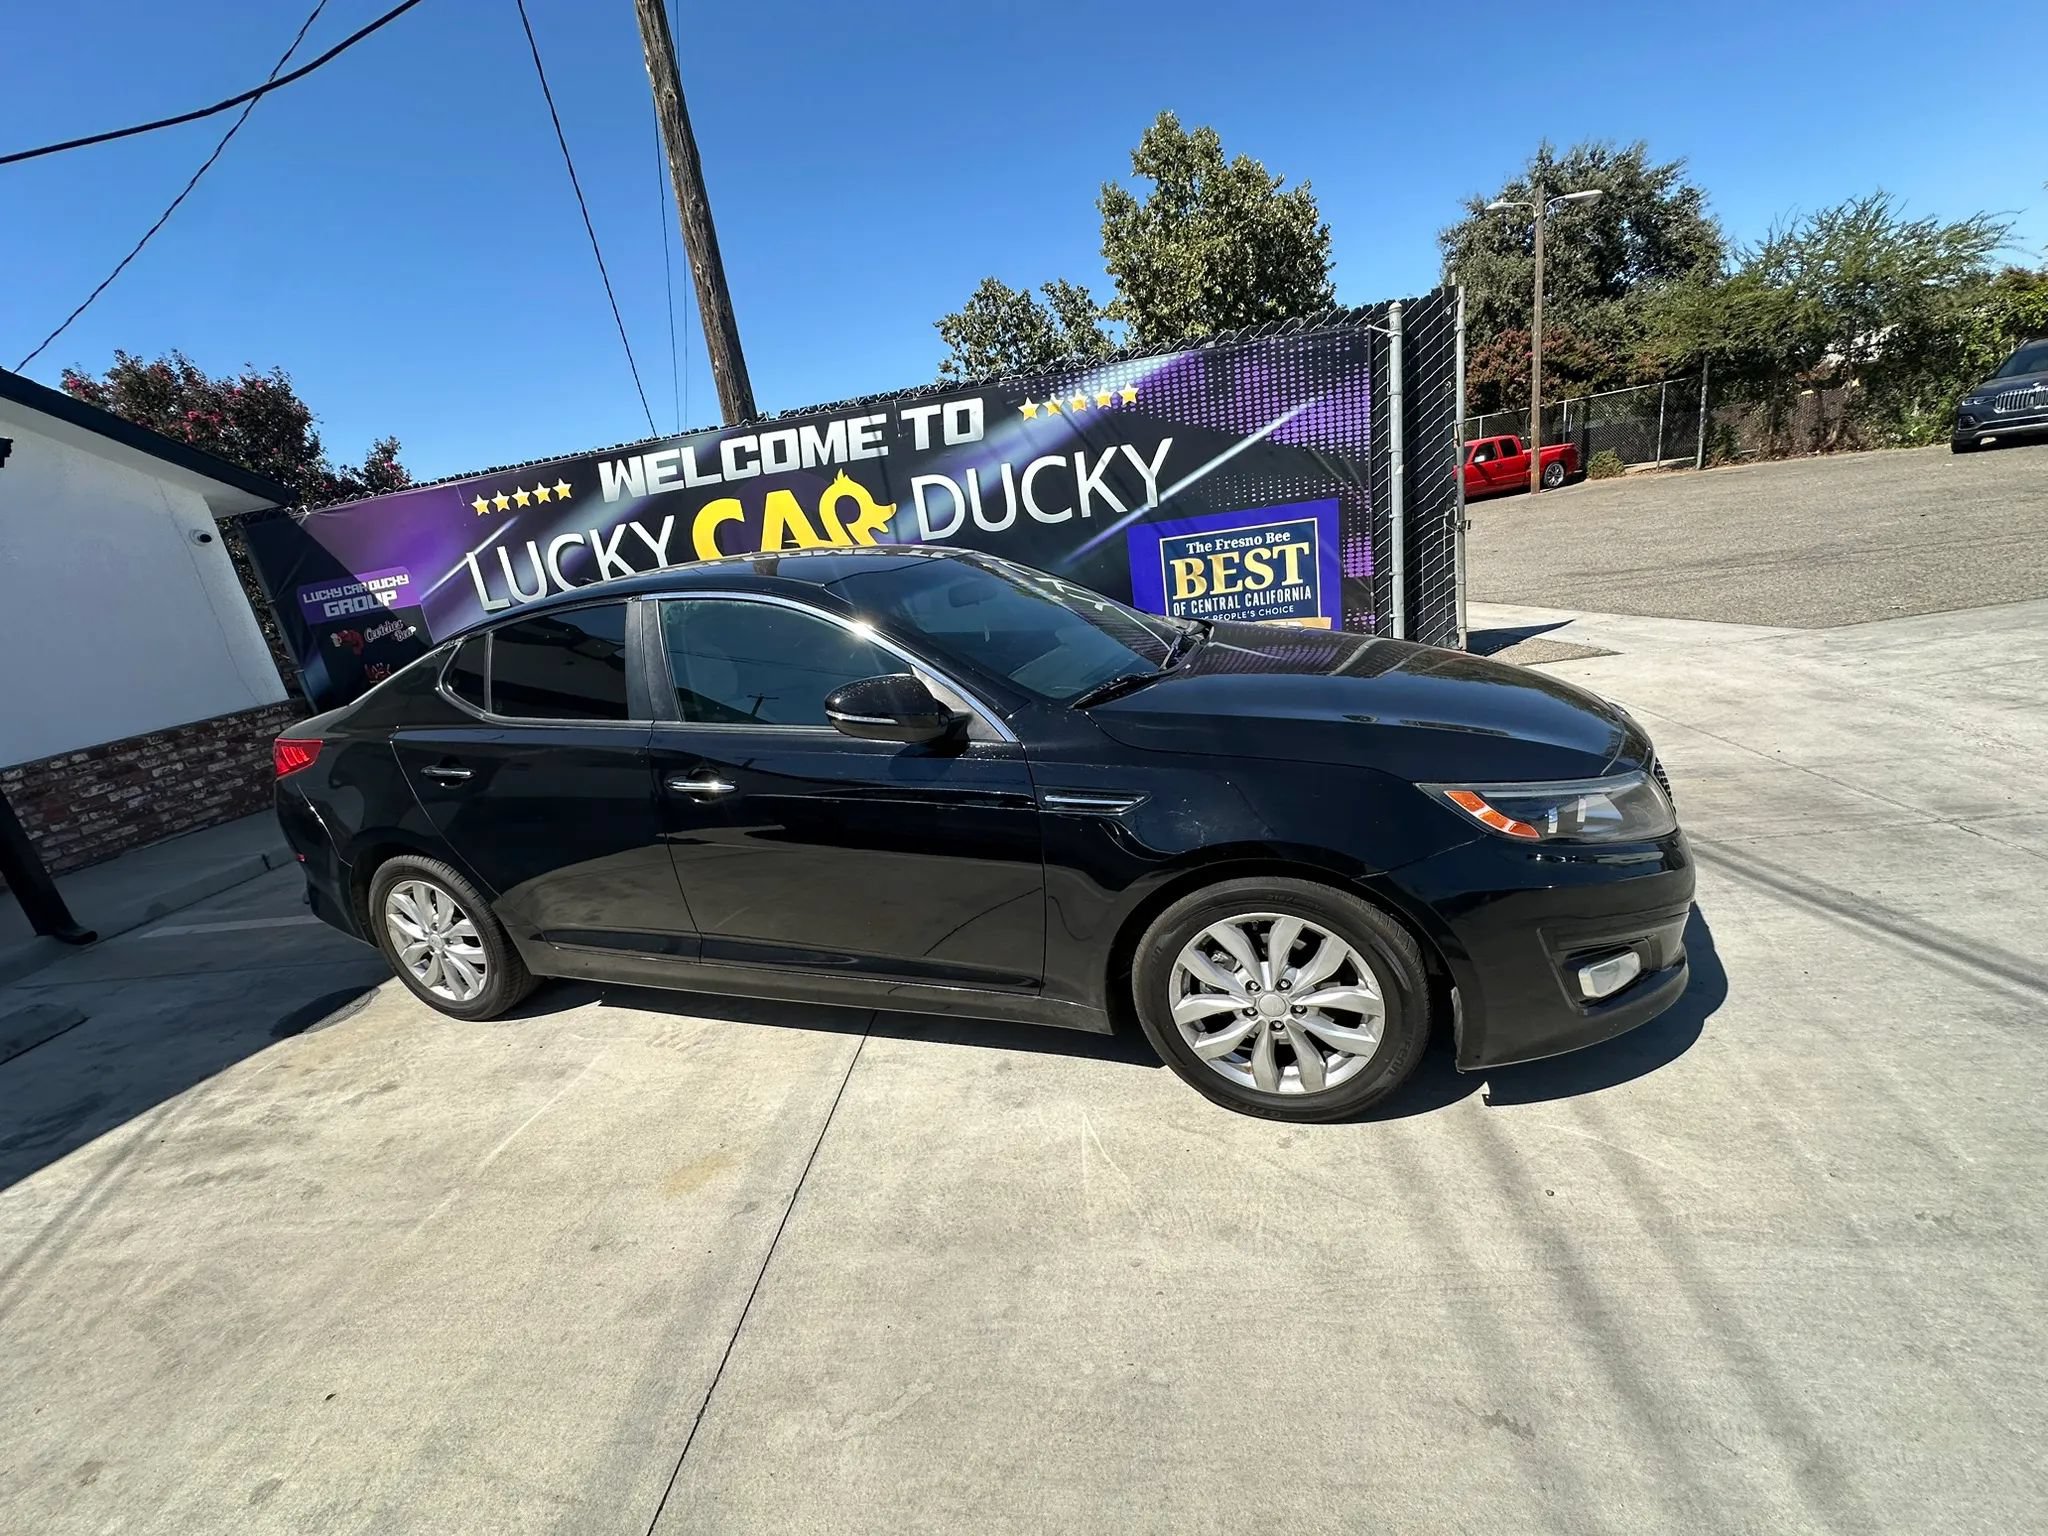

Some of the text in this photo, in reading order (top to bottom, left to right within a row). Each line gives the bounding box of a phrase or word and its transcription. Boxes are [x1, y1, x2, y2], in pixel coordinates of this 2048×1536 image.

[598, 397, 984, 503] WELCOME TO
[466, 515, 675, 611] LUCKY
[910, 437, 1173, 542] DUCKY
[1186, 530, 1291, 555] The Fresno Bee
[1170, 542, 1310, 600] BEST
[302, 573, 410, 603] LUCKY CAR DUCKY
[1173, 585, 1312, 617] OF CENTRAL CALIFORNIA
[323, 590, 398, 618] GROUP
[1258, 605, 1294, 617] CHOICE
